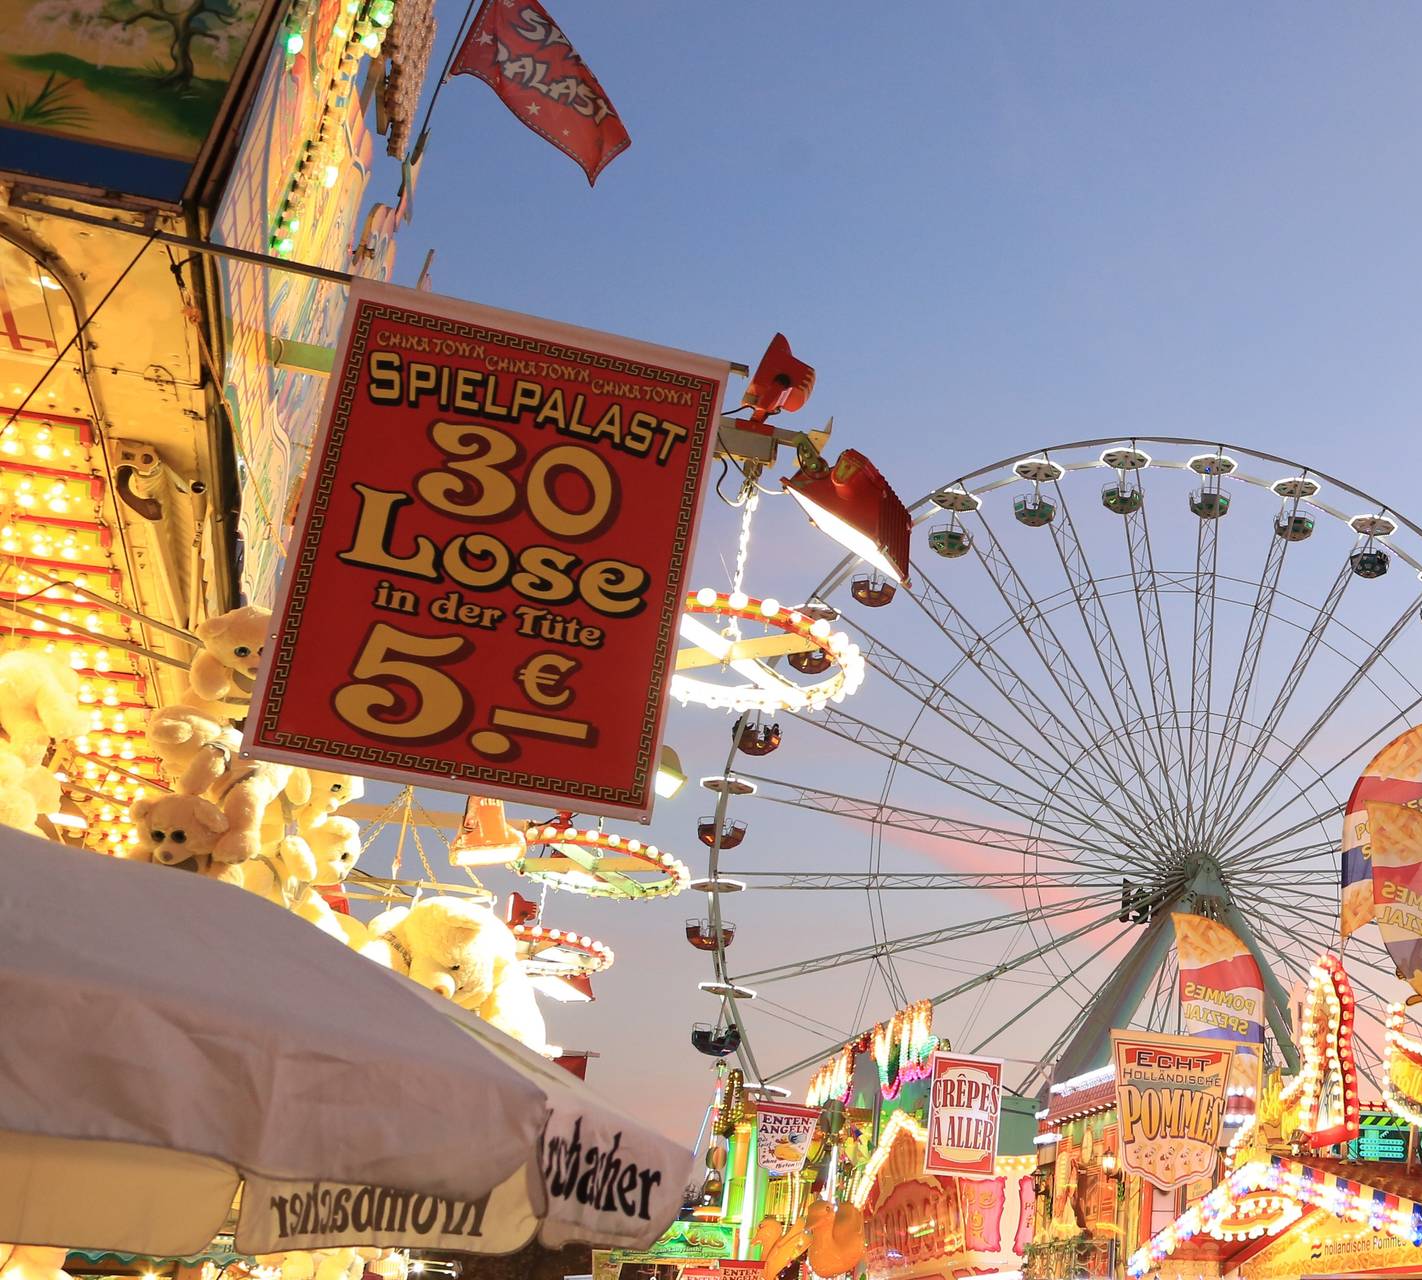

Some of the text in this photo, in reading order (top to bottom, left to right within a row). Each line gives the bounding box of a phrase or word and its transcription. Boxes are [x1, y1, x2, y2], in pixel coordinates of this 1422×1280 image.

[369, 351, 688, 461] SPIELPALAST
[417, 420, 614, 537] 30
[375, 580, 605, 649] in der Tüte
[518, 653, 578, 706] €
[1123, 1067, 1222, 1087] HOLLÄNDISCHE
[1136, 1050, 1211, 1072] ECHT
[931, 1073, 1000, 1115] CRÊPES
[1118, 1084, 1226, 1147] POMMES
[759, 1124, 810, 1134] ANGELN
[932, 1110, 994, 1150] À ALLER
